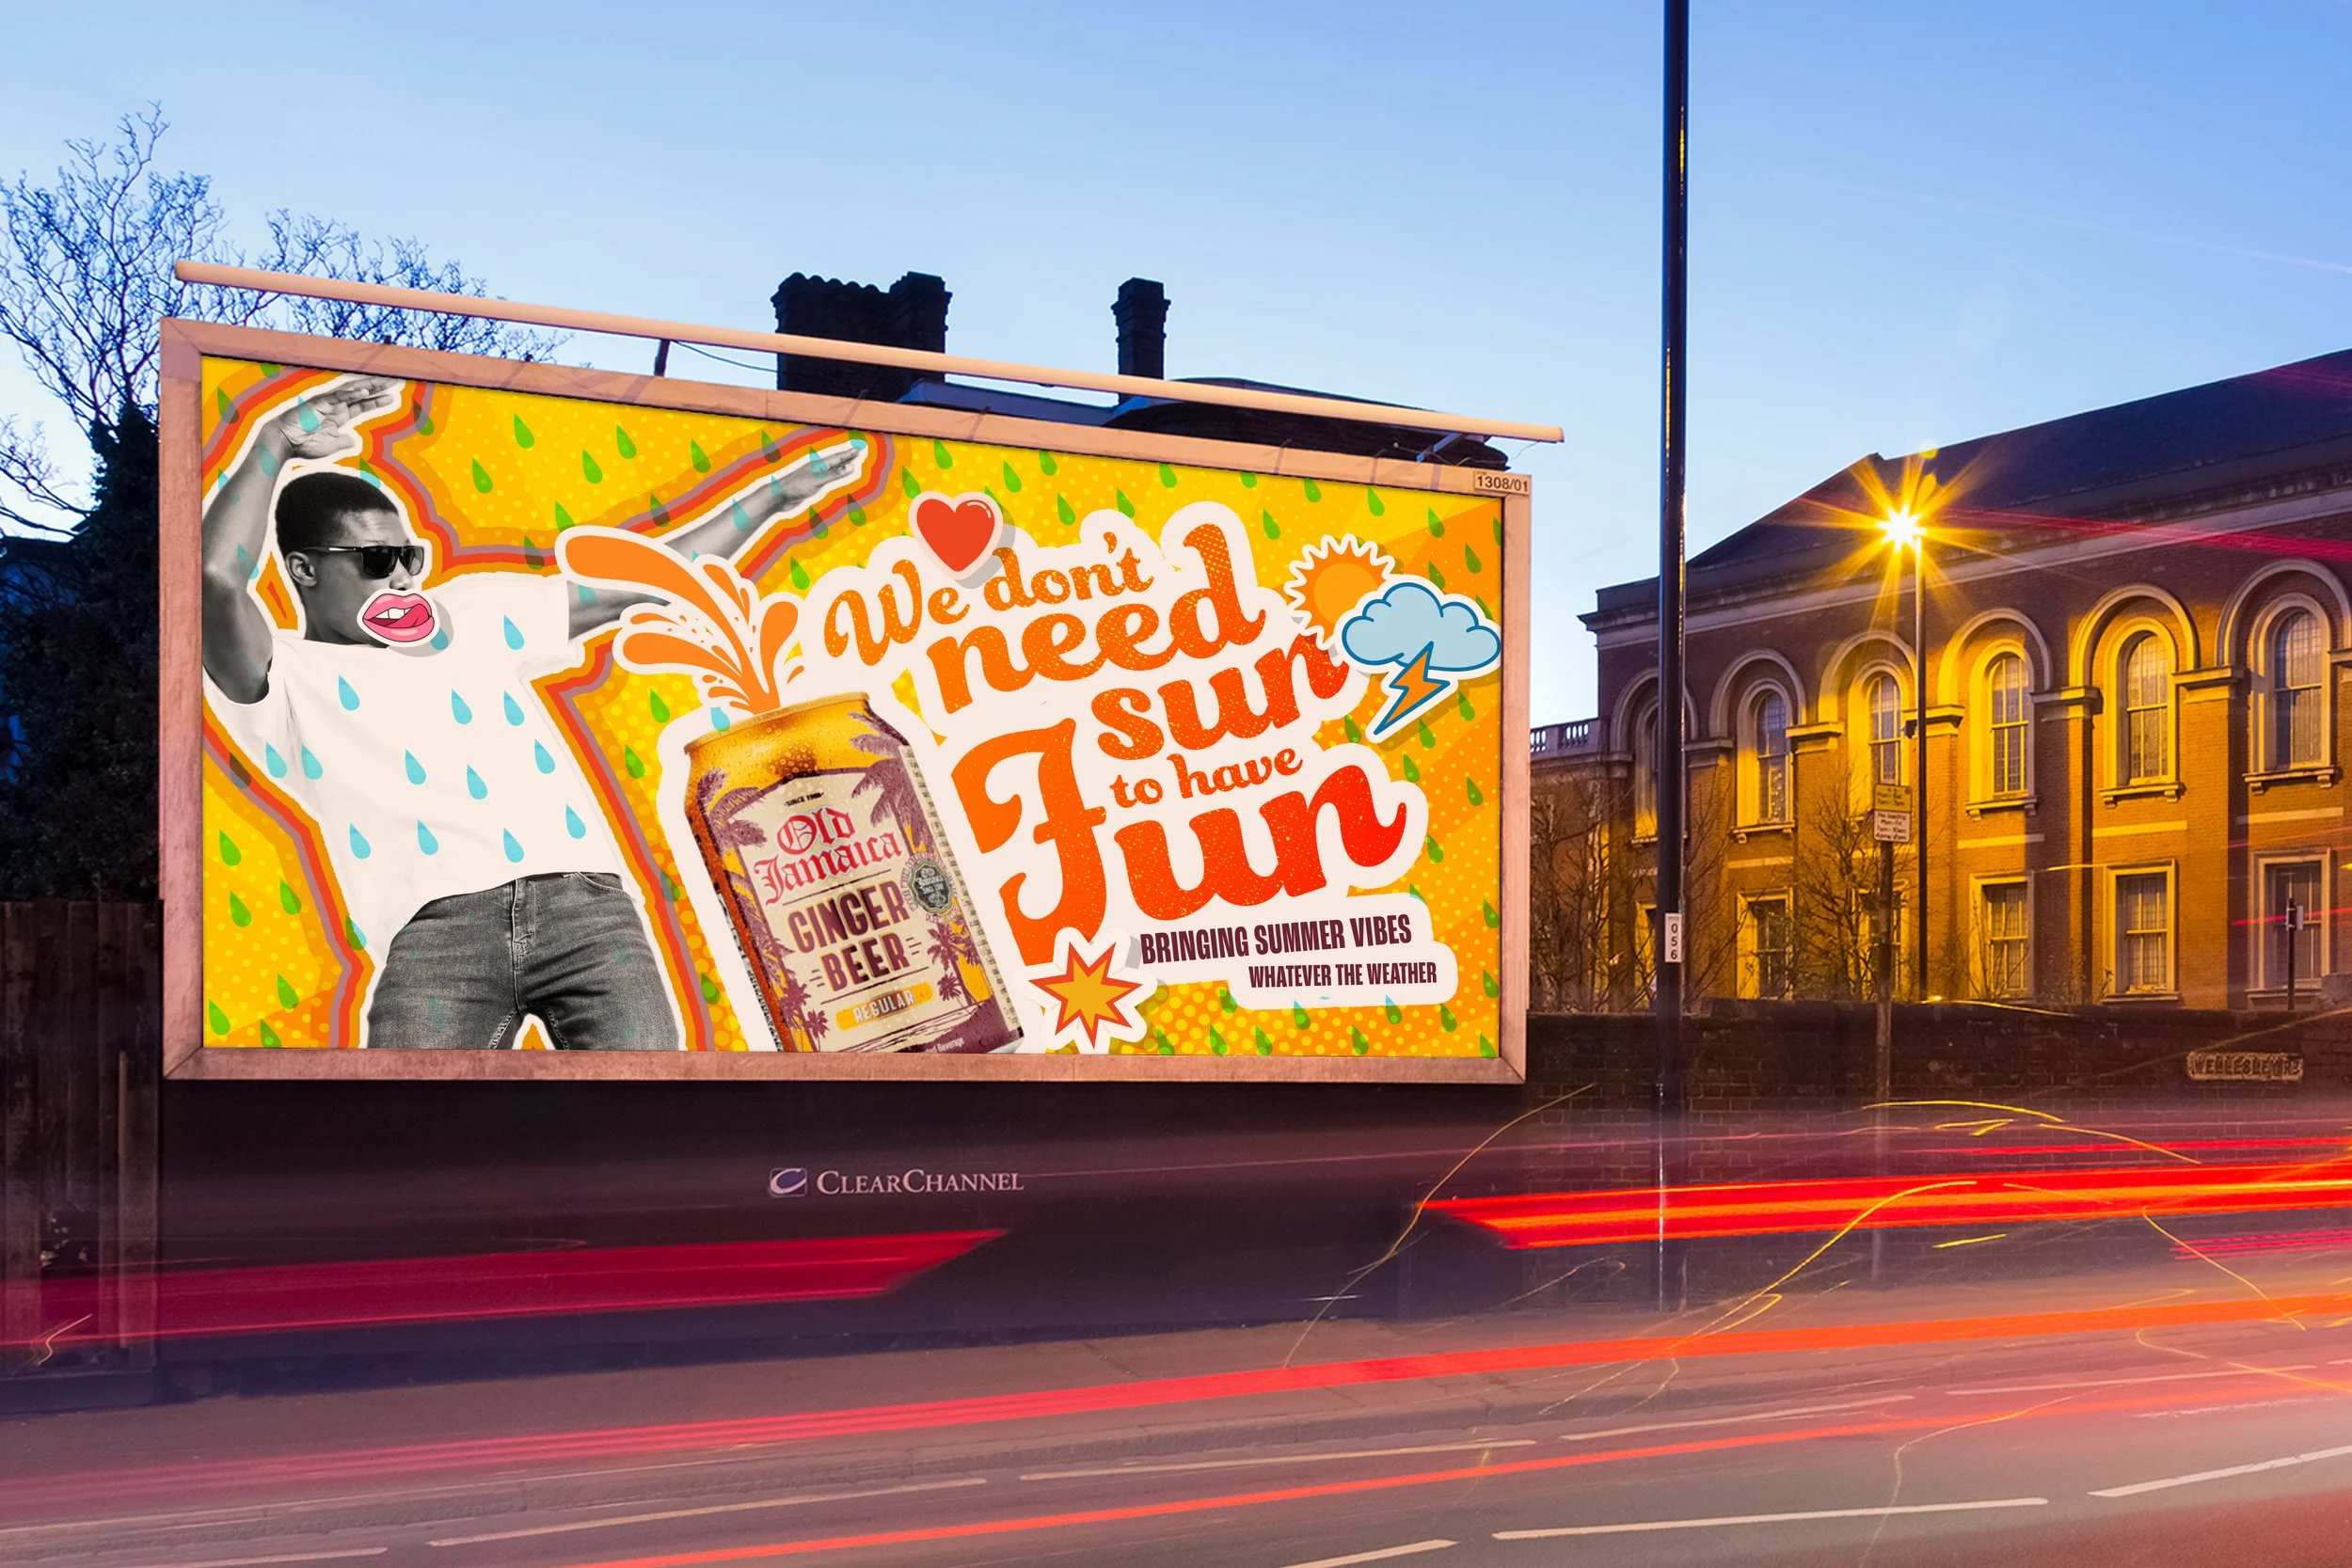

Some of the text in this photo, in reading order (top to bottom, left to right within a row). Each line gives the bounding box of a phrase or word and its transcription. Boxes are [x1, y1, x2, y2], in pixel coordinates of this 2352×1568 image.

[1476, 475, 1529, 492] 1308/01
[823, 531, 1154, 667] We don't
[926, 523, 1267, 715] need
[1090, 632, 1350, 761] sun
[1109, 748, 1304, 809] to have
[776, 807, 856, 856] Old
[950, 717, 1407, 967] Fun
[753, 832, 903, 907] Jamaica
[788, 879, 911, 954] GINGER
[1140, 913, 1412, 965] BRINGING SUMMER VIBES
[1670, 923, 1679, 960] 056
[820, 932, 911, 992] BEER
[1248, 961, 1438, 989] WHATEVER THE WEATHER
[852, 989, 916, 1024] REGULAR
